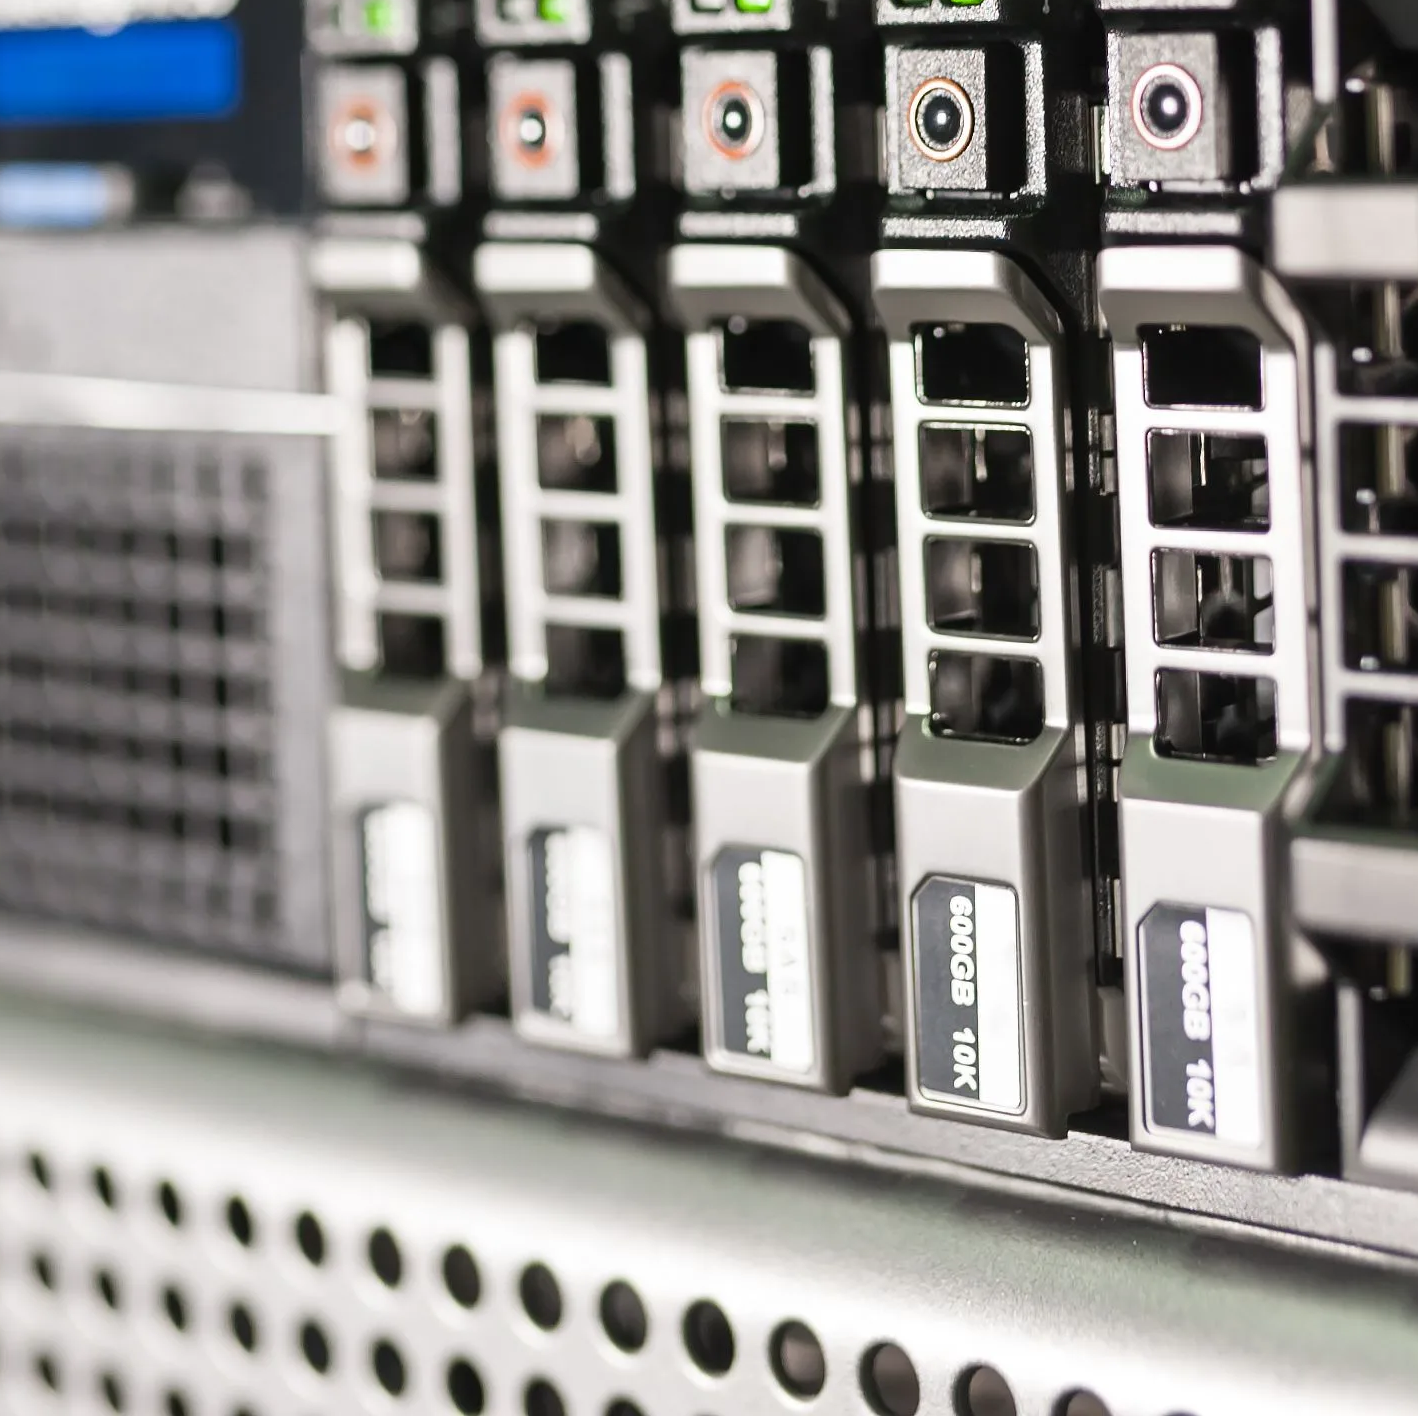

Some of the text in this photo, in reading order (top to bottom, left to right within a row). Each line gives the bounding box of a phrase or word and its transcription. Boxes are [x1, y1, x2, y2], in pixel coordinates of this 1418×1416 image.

[950, 895, 977, 1092] 600GB 10K
[1180, 920, 1216, 1130] 600GB 10K
